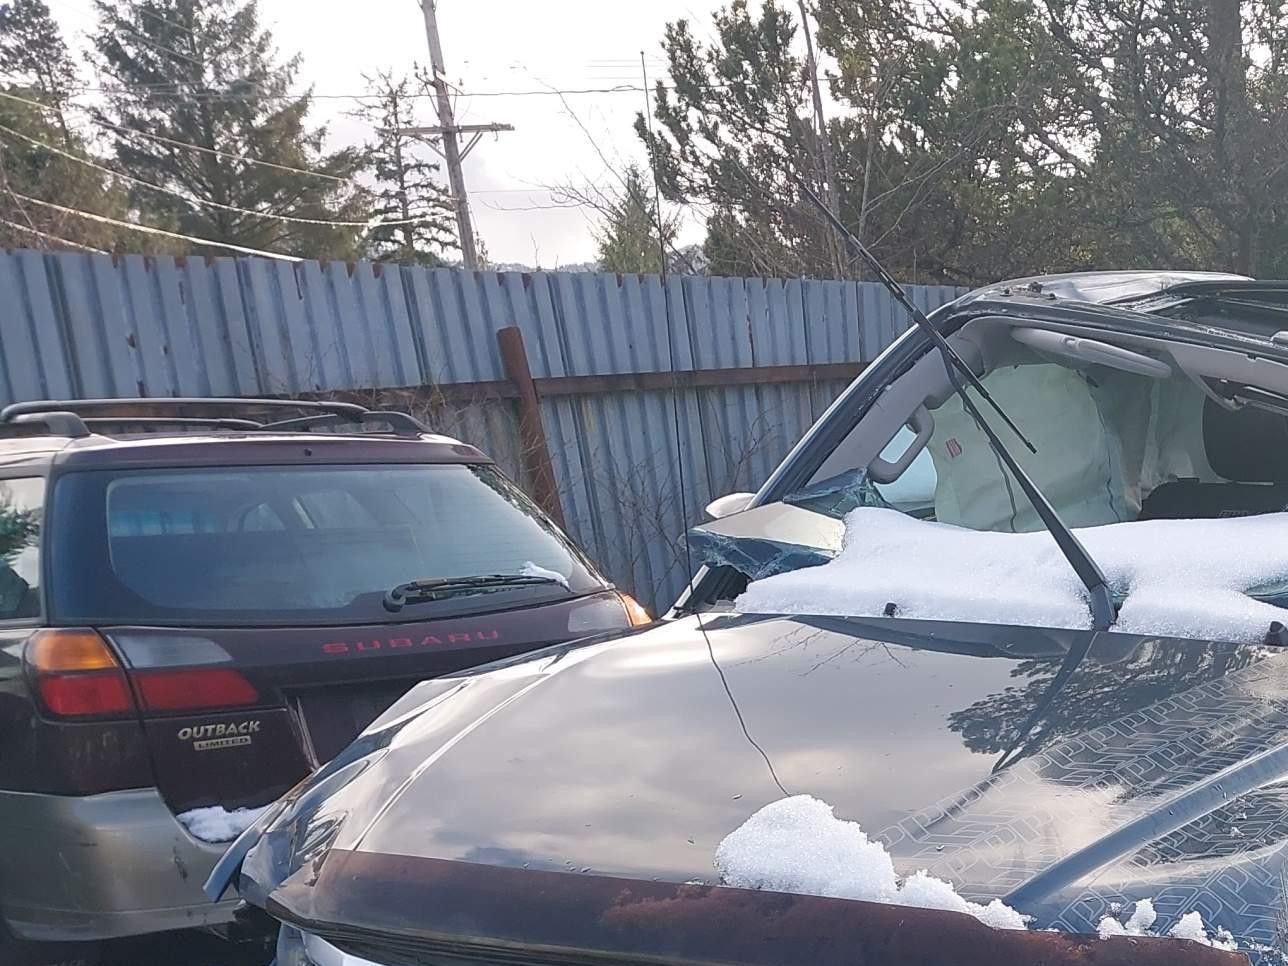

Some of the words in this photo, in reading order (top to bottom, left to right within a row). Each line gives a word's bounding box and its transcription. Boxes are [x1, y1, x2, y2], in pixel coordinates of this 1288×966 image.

[322, 630, 498, 655] SUBARU
[177, 720, 261, 740] OUTBACK
[196, 737, 250, 749] LIMITED
